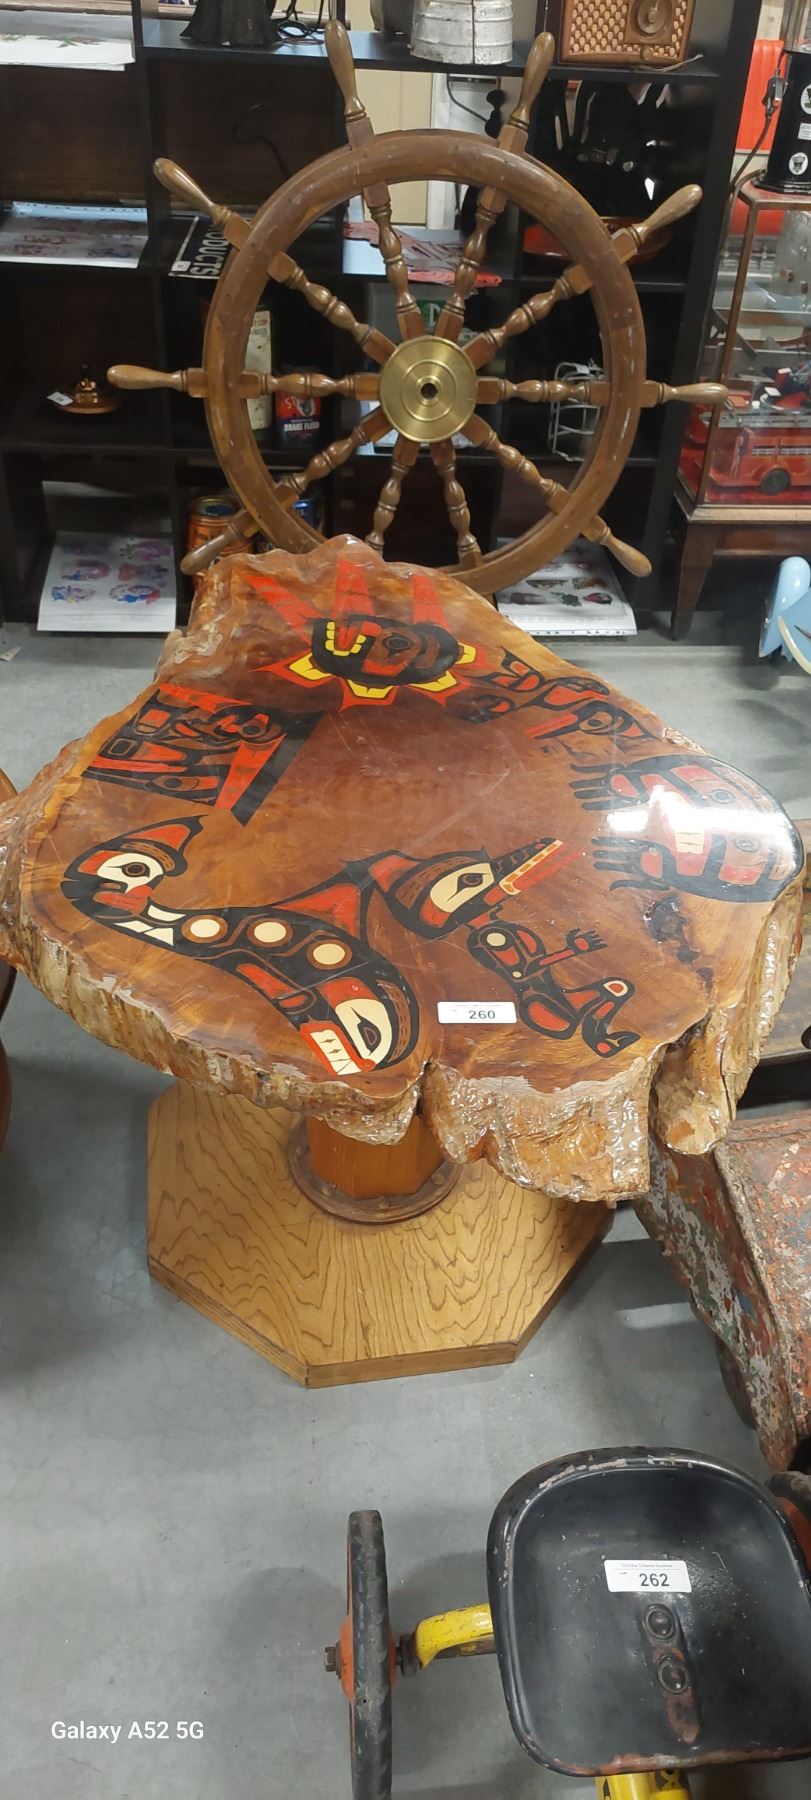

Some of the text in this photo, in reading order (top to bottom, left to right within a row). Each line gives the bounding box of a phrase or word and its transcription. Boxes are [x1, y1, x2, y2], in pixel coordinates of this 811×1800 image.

[190, 225, 229, 275] ODUCTS
[468, 1010, 496, 1020] 260
[639, 1573, 670, 1587] 262
